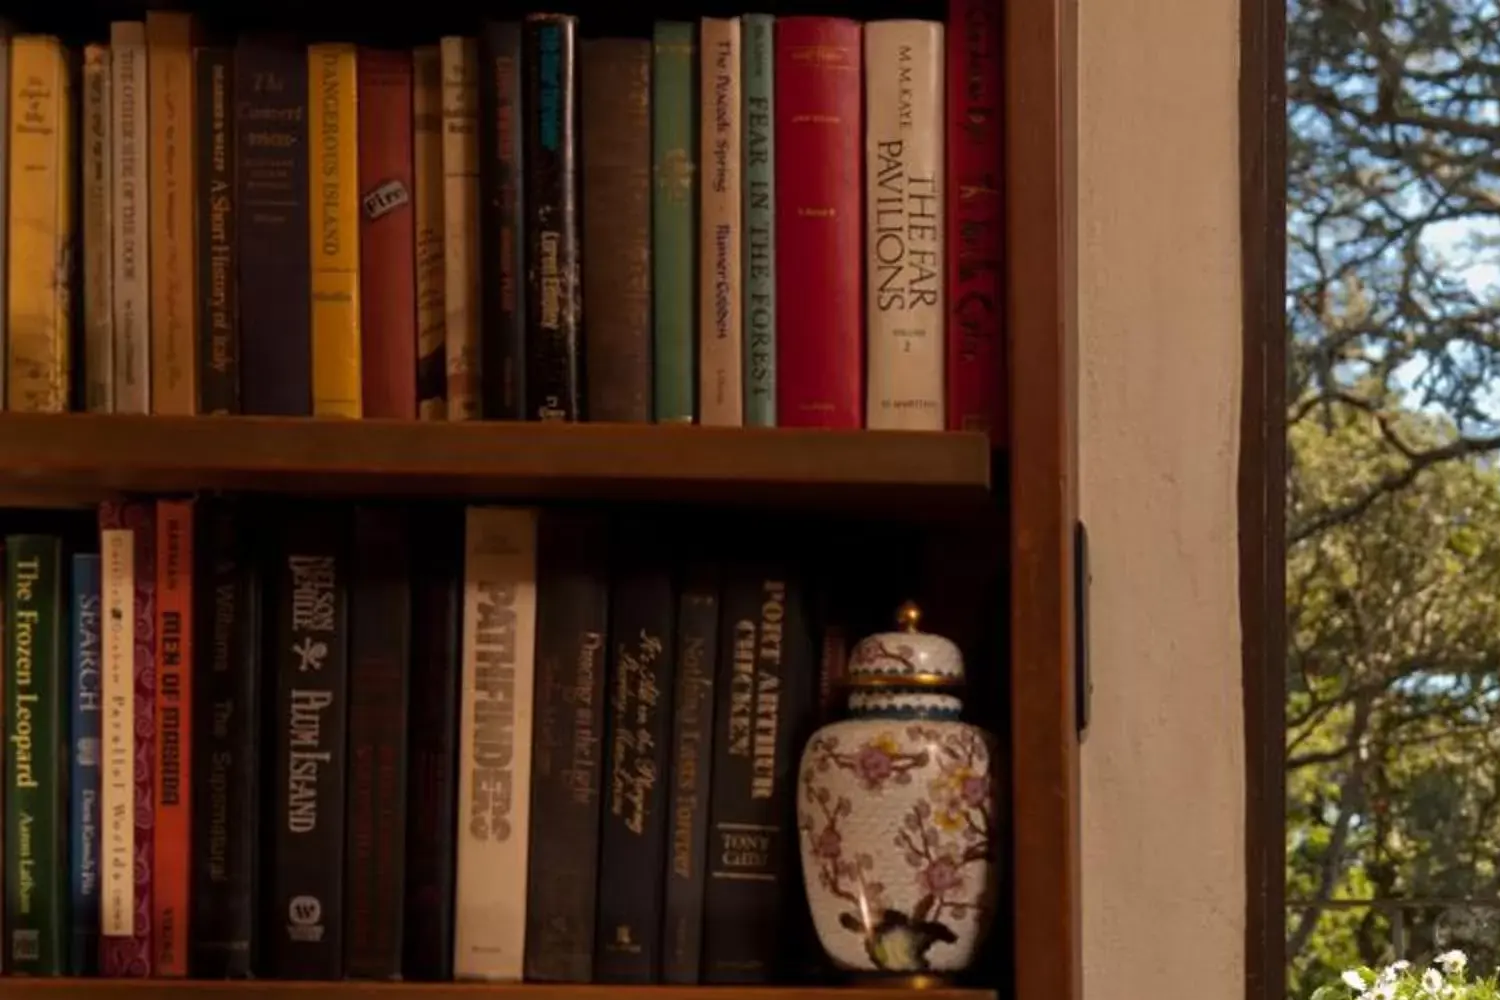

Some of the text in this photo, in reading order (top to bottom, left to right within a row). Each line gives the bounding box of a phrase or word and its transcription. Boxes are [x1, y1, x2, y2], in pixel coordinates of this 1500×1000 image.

[322, 54, 341, 256] DANGEROUS ISLAND
[711, 41, 731, 194] The Peacock Spring
[747, 96, 769, 167] FEAR
[210, 180, 231, 192] A
[210, 195, 231, 241] Short
[748, 181, 769, 210] IN
[876, 139, 905, 312] PAVILIONS
[206, 245, 231, 307] History
[715, 224, 732, 278] Rumer
[748, 222, 770, 279] THE
[908, 170, 938, 311] THE FAR
[211, 311, 231, 329] of
[749, 292, 772, 402] FOREST
[213, 583, 236, 672] Williams
[312, 555, 336, 632] NELSON
[9, 555, 40, 788] The Frozen Leopard
[78, 594, 99, 712] SEARCH
[161, 611, 182, 667] MEN
[162, 672, 181, 700] OF
[470, 579, 518, 844] PATHFINDERS
[728, 619, 755, 759] CHICKEN
[750, 579, 786, 800] PORT ARTHUR
[206, 697, 235, 882] The Supernatural
[289, 689, 333, 833] PLUM ISLAND
[673, 634, 713, 880] Nothing Lasts Forever
[111, 803, 127, 881] Worlds
[722, 832, 769, 850] TONY
